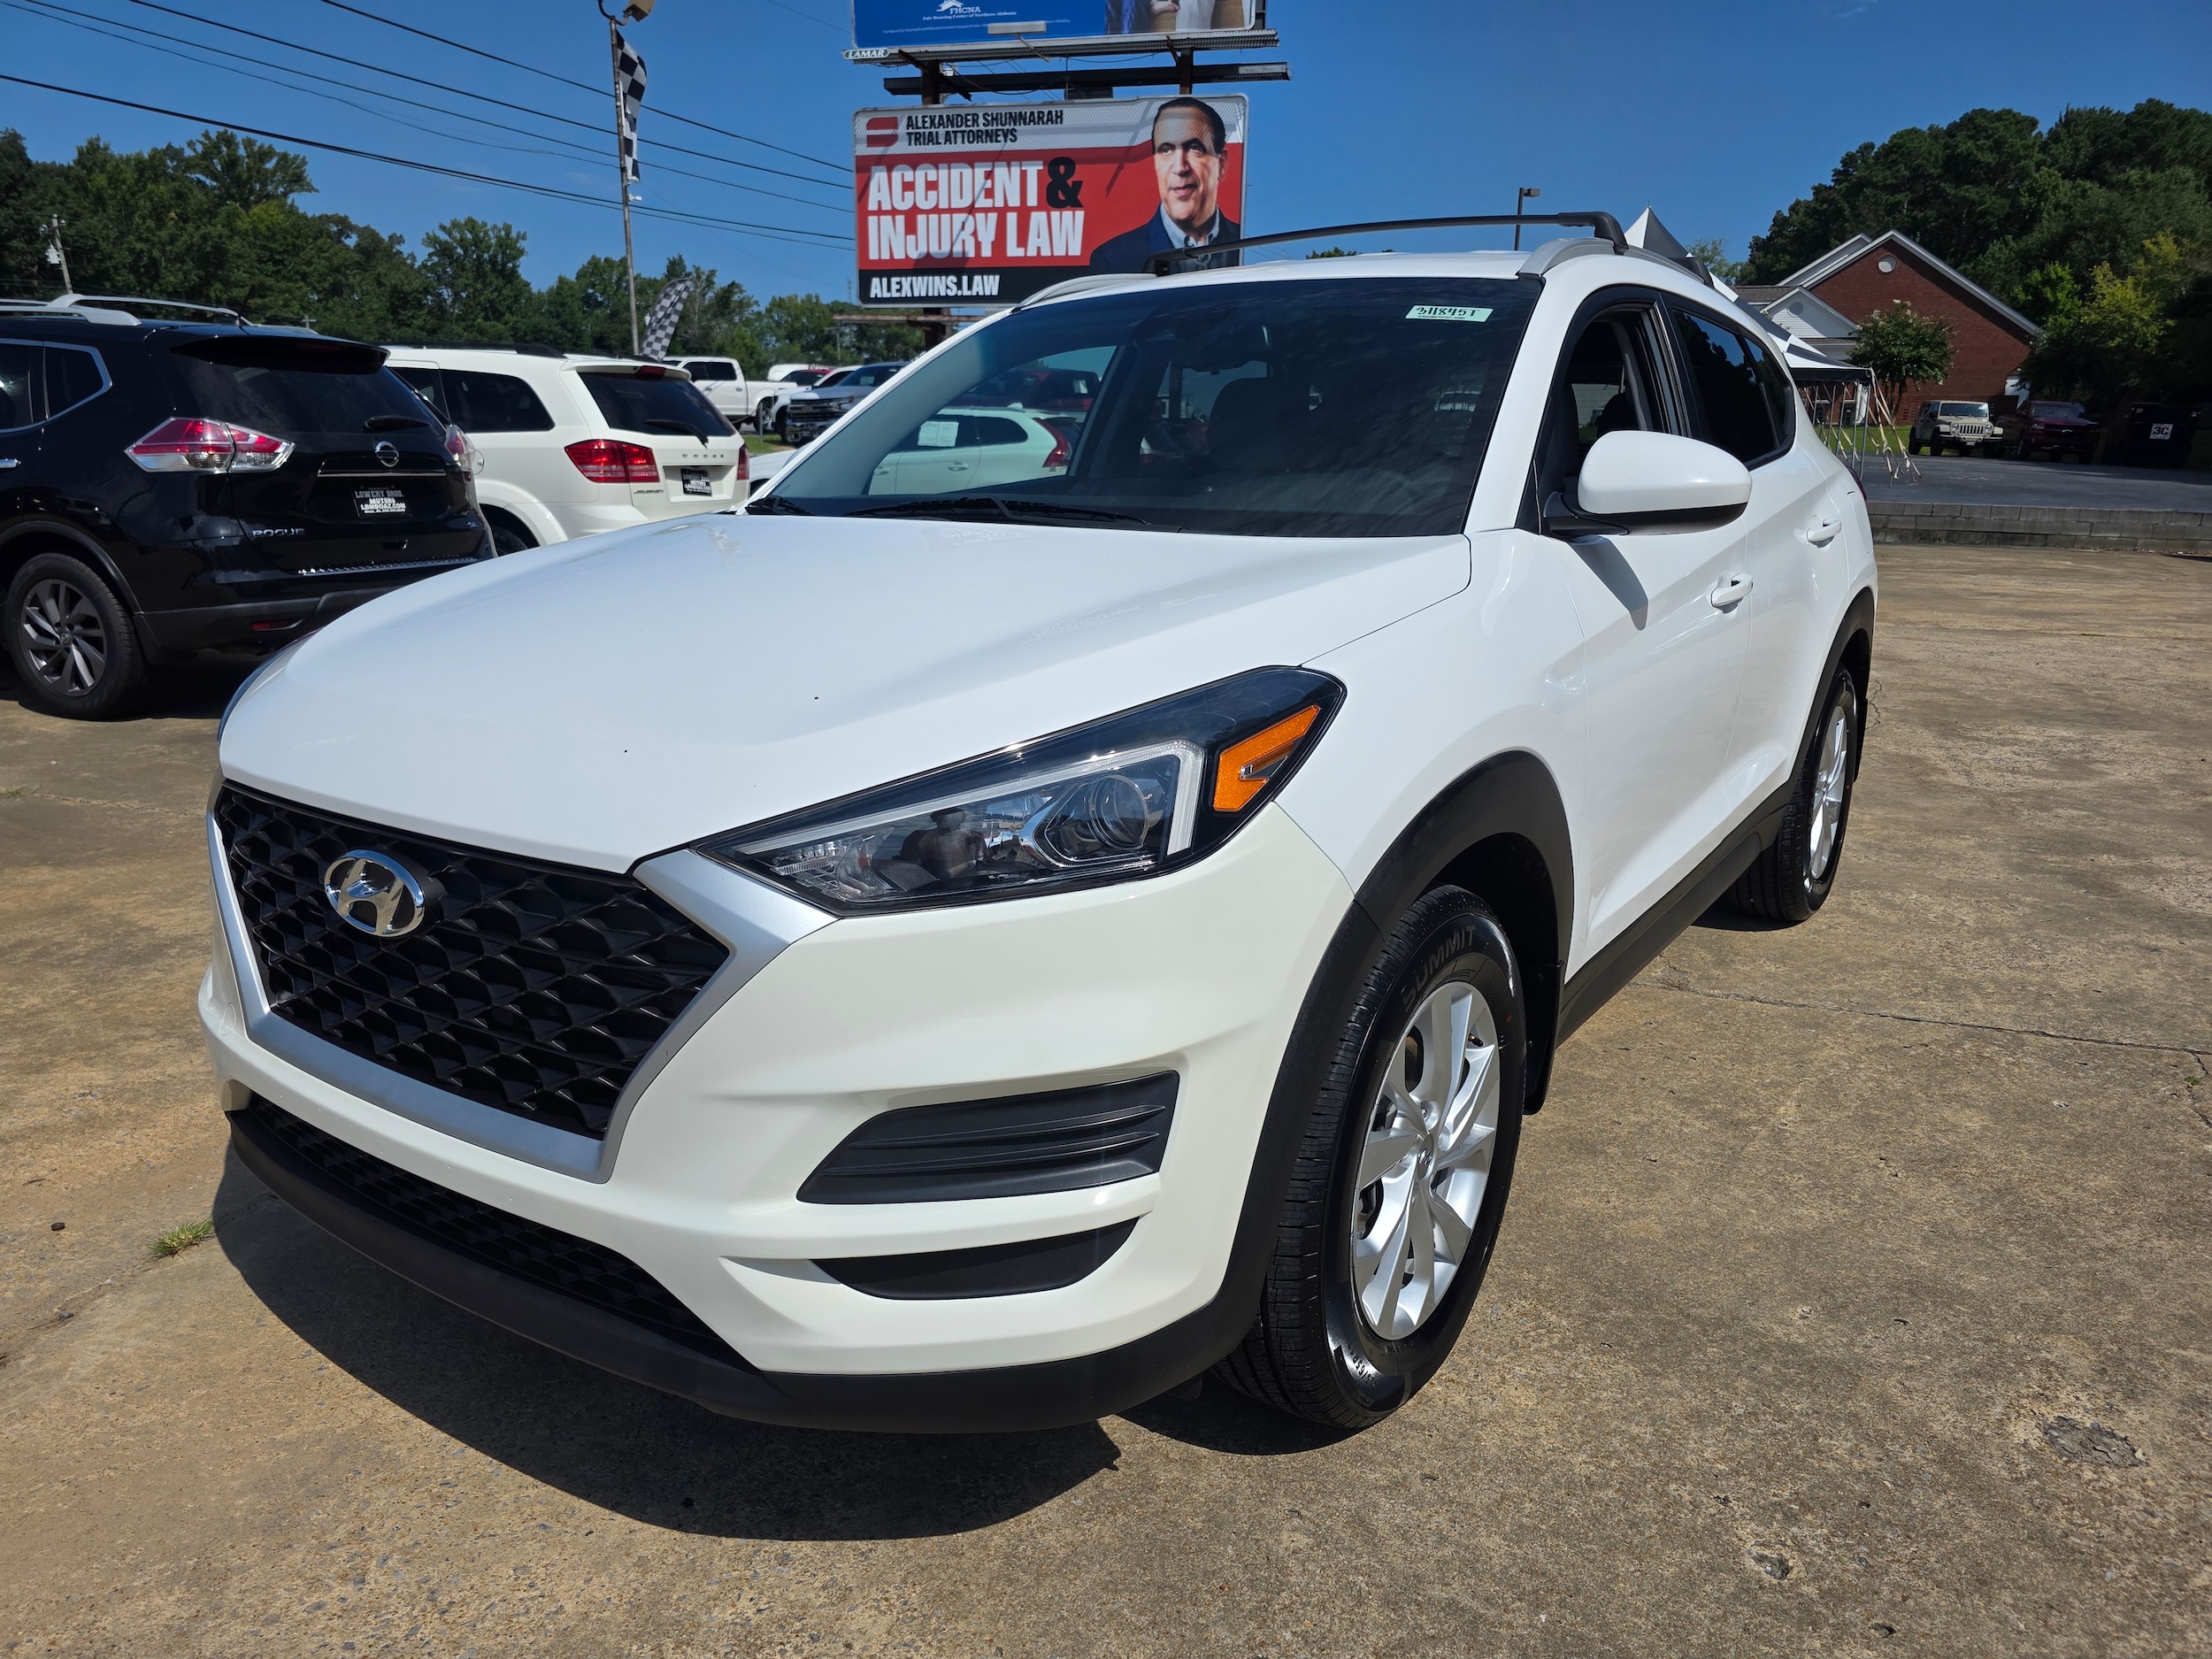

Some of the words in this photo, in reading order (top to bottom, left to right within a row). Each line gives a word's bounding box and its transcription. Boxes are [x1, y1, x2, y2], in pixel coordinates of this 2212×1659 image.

[949, 6, 981, 15] FHCNA
[847, 50, 885, 58] LAMAR
[906, 112, 979, 130] ALEXANDER
[982, 110, 1064, 127] SHUNNARAH
[906, 131, 944, 147] TRIAL
[944, 127, 1018, 145] ATTORNEYS
[867, 160, 1044, 211] ACCIDENT
[1046, 157, 1085, 209] &
[867, 211, 998, 260] INJURY
[1006, 211, 1085, 257] LAW
[870, 274, 1001, 298] ALEXWINS.LAW
[2153, 426, 2170, 435] 3C
[1402, 925, 1477, 1013] SUMMIT
